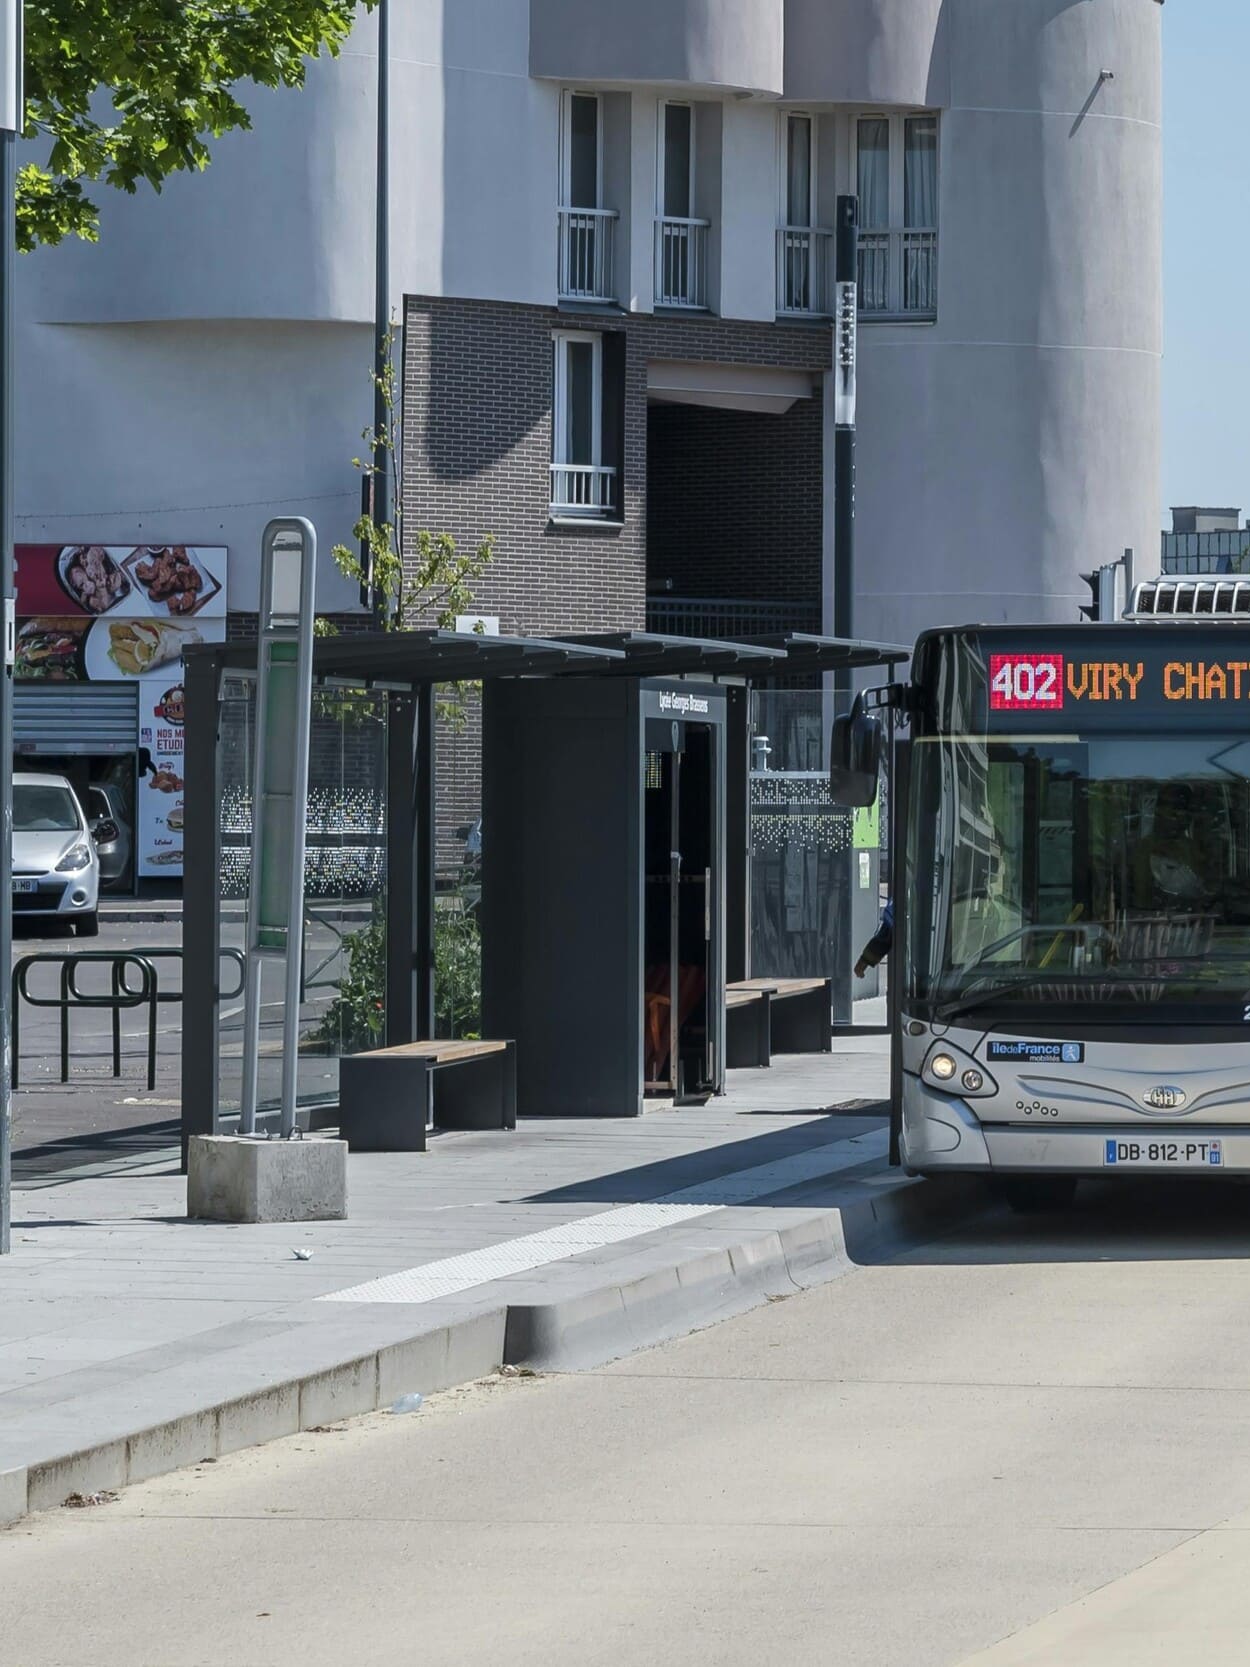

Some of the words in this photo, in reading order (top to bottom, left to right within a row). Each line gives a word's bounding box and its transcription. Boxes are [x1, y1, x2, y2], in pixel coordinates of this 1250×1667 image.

[992, 663, 1056, 700] 402
[1067, 662, 1144, 700] VIRY
[660, 690, 671, 712] Lycée
[672, 692, 689, 715] Georges
[157, 729, 172, 738] NOS
